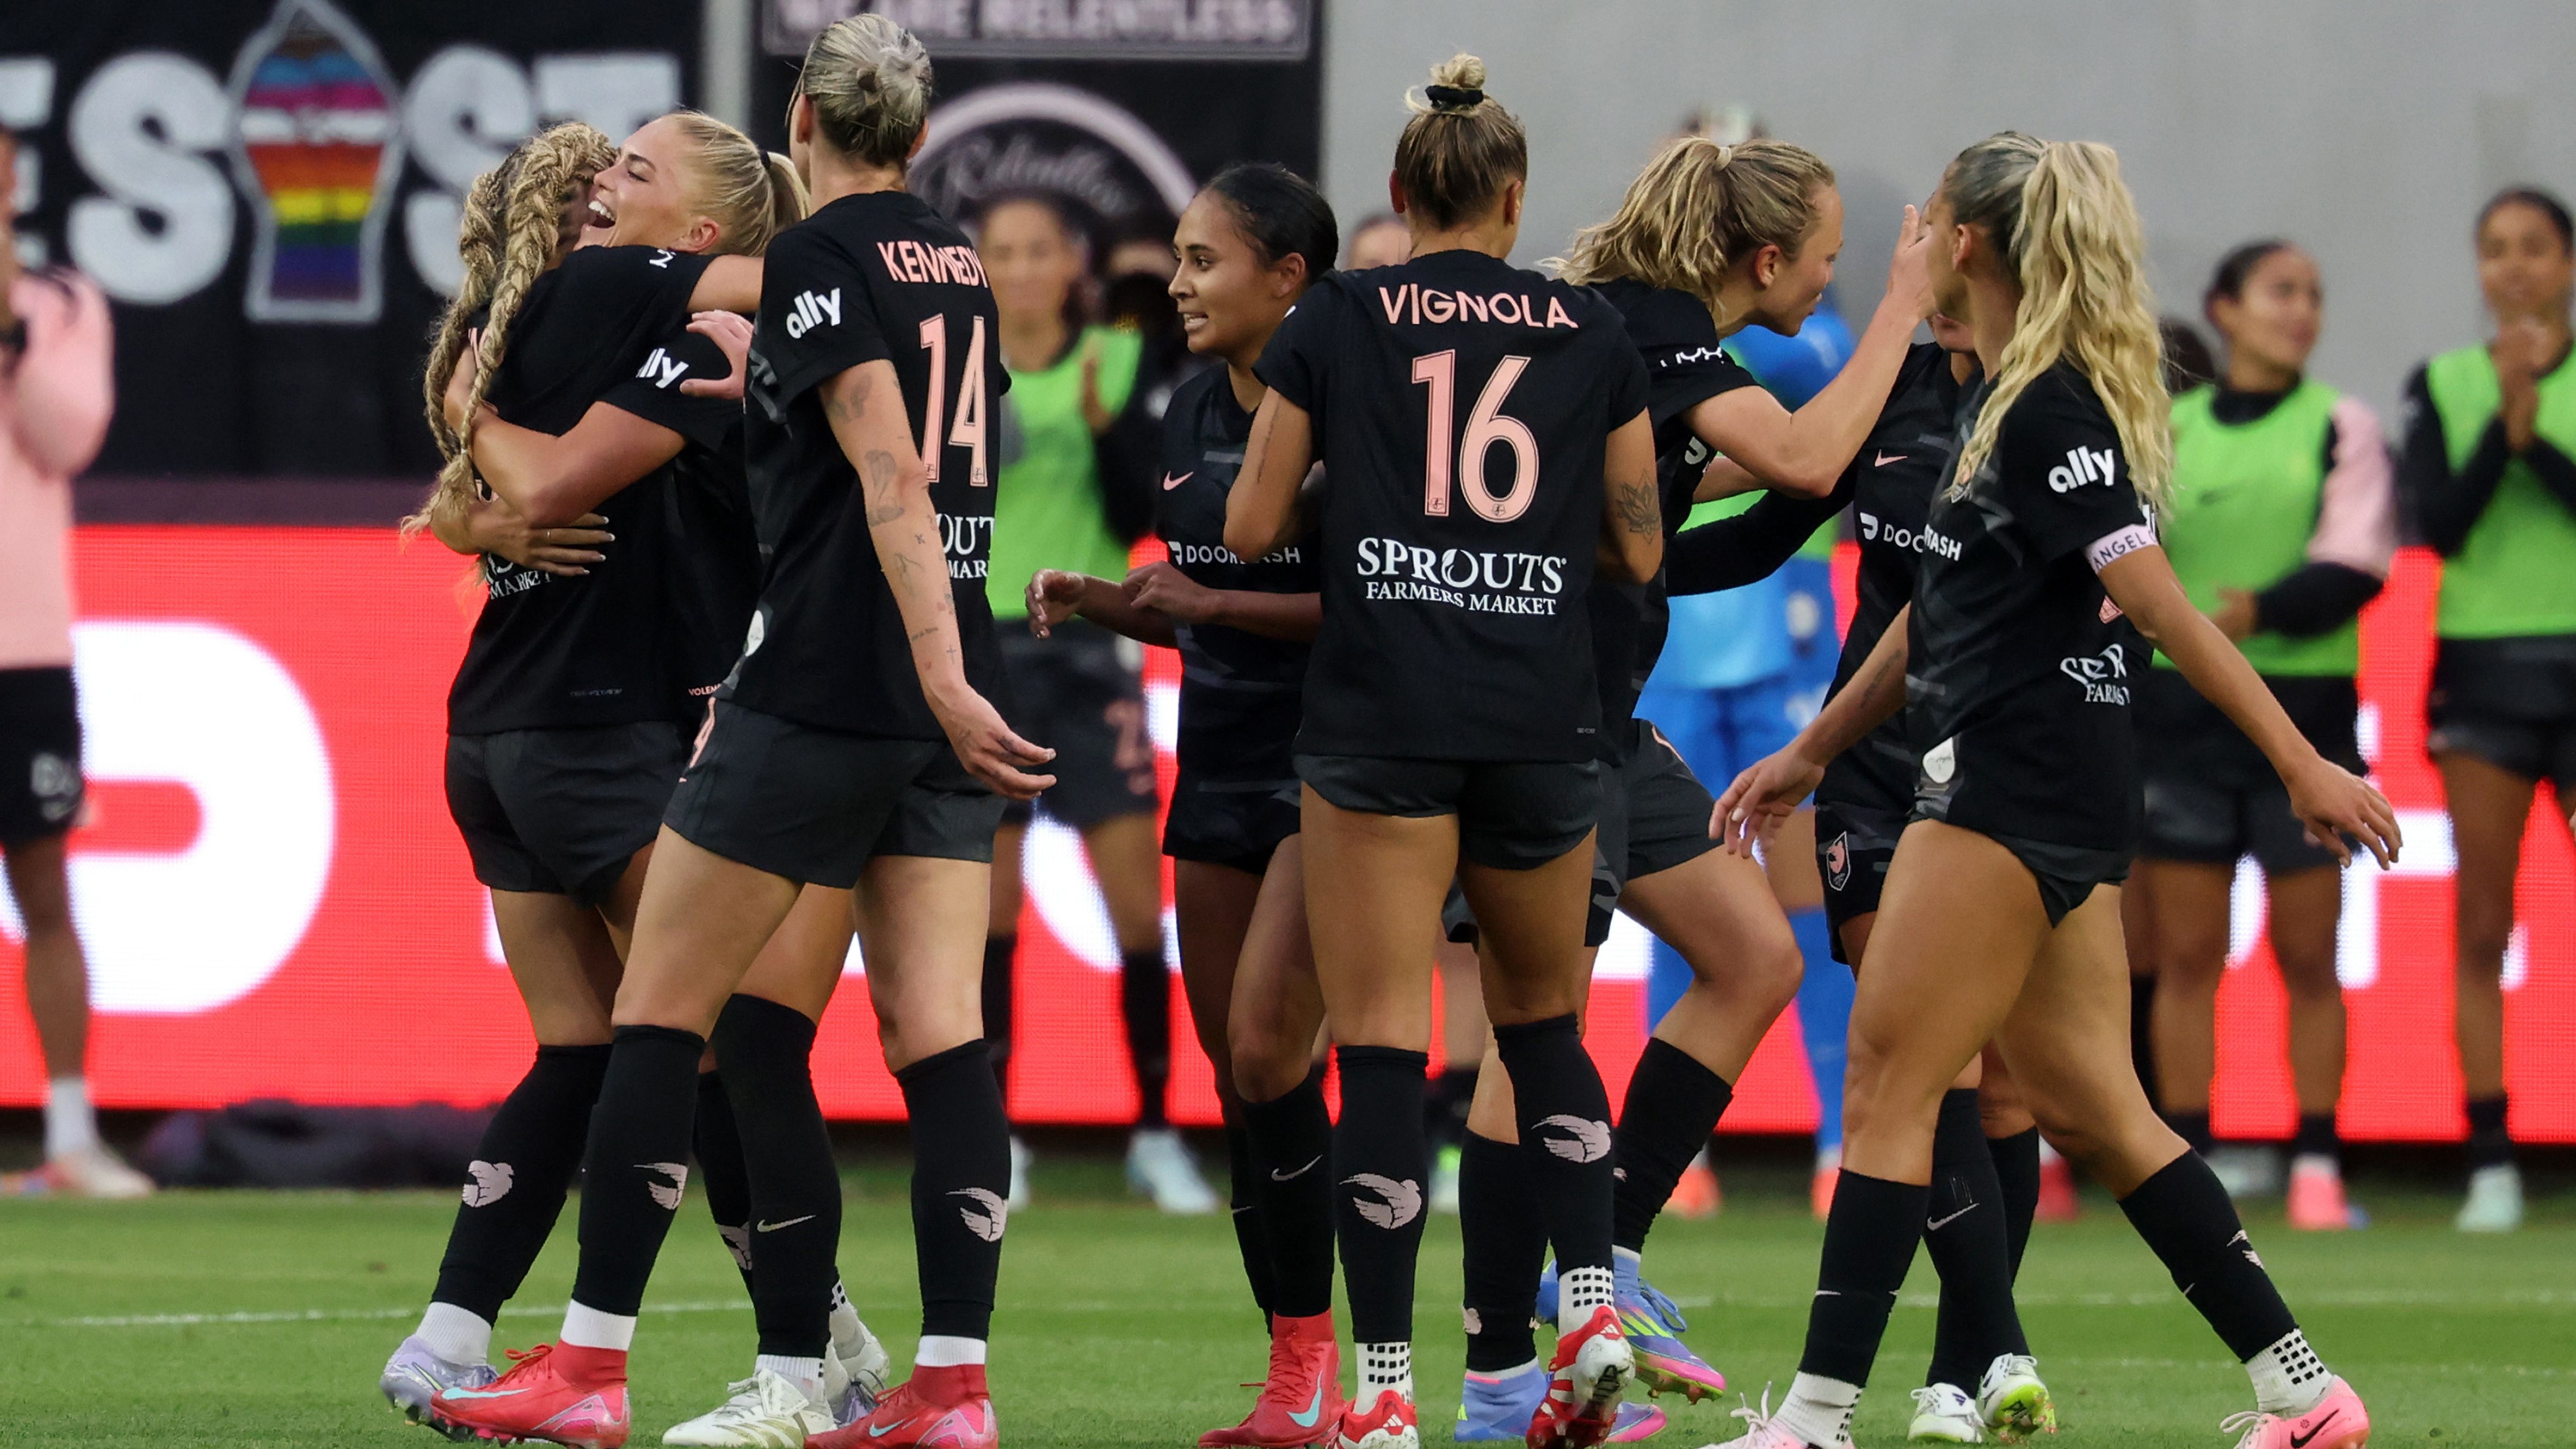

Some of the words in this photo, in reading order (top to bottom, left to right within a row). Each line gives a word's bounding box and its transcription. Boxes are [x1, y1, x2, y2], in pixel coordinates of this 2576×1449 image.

[786, 288, 841, 339] ally
[1379, 283, 1579, 328] VIGNOLA
[635, 348, 689, 389] lly
[919, 312, 988, 487] 14
[1412, 349, 1539, 523] 16
[2049, 446, 2115, 493] ally
[1357, 537, 1564, 594] SPROUTS
[2093, 532, 2147, 570] ANGEL
[1366, 582, 1464, 608] FARMERS
[1469, 593, 1556, 615] MARKET
